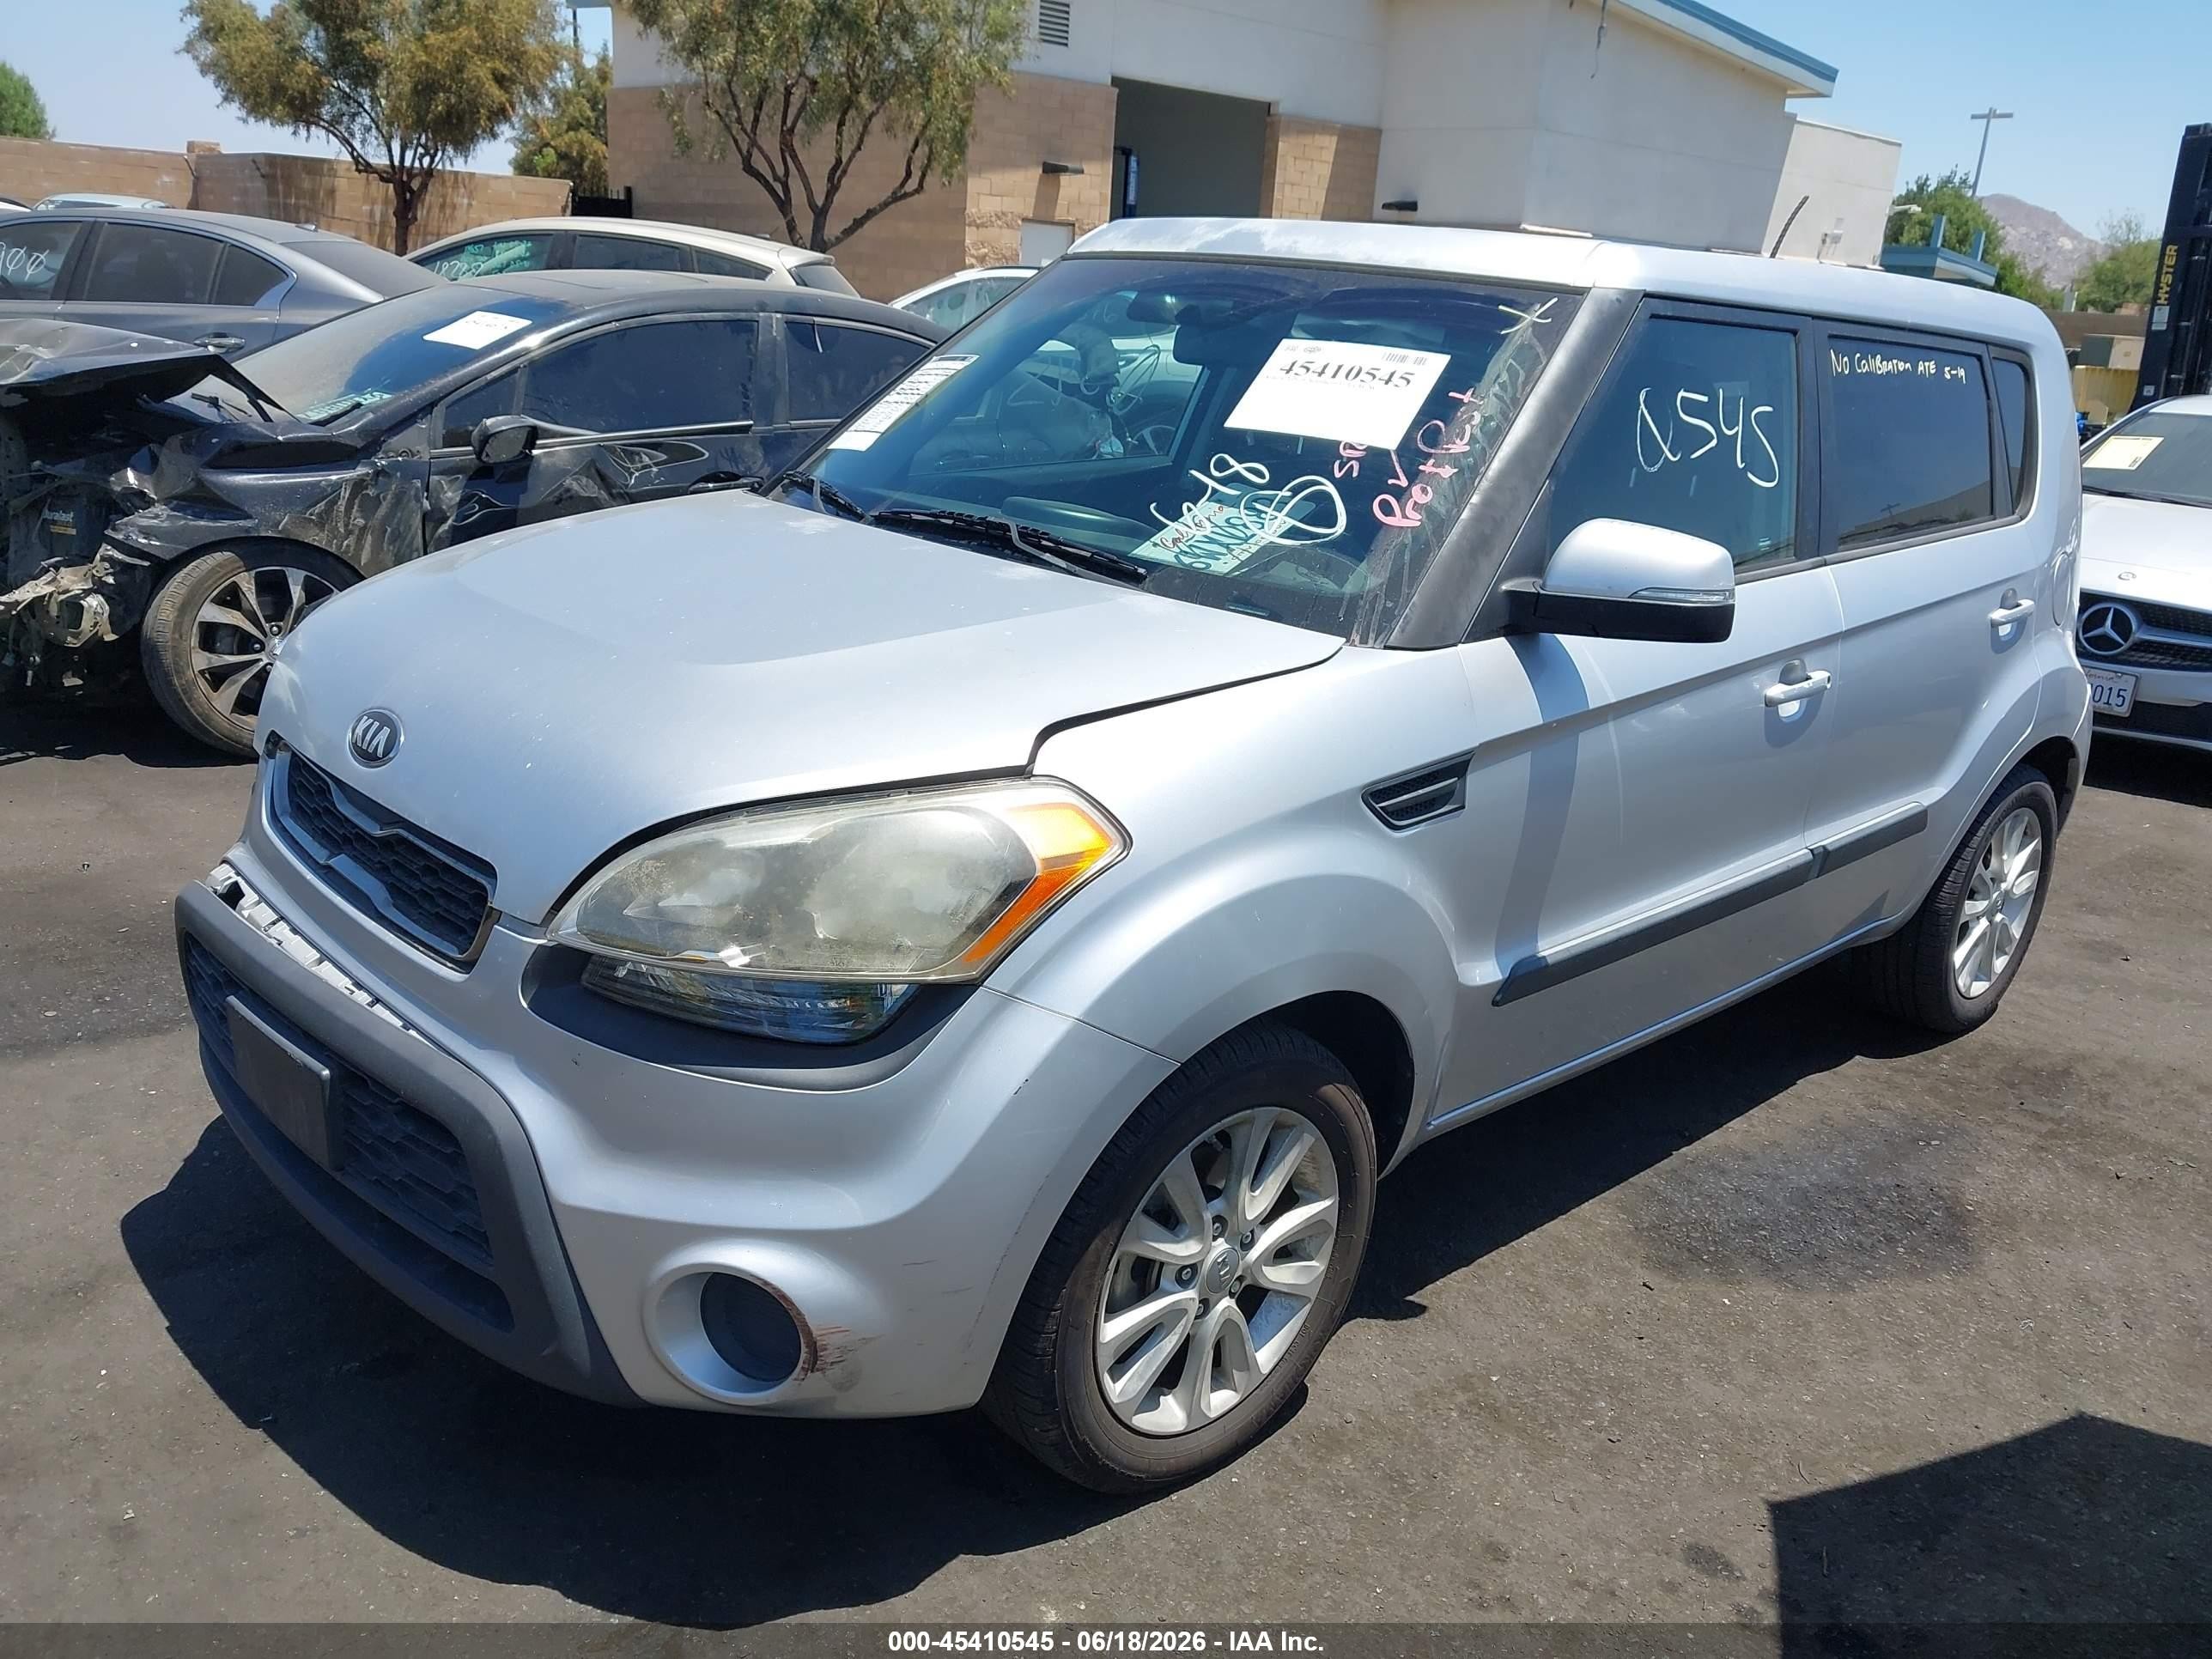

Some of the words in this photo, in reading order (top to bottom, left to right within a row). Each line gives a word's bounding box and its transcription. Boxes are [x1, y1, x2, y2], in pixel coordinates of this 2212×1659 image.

[2156, 245, 2179, 304] HYSTER
[1279, 359, 1416, 388] 45410545
[2091, 684, 2128, 708] 015
[352, 715, 391, 757] KIA
